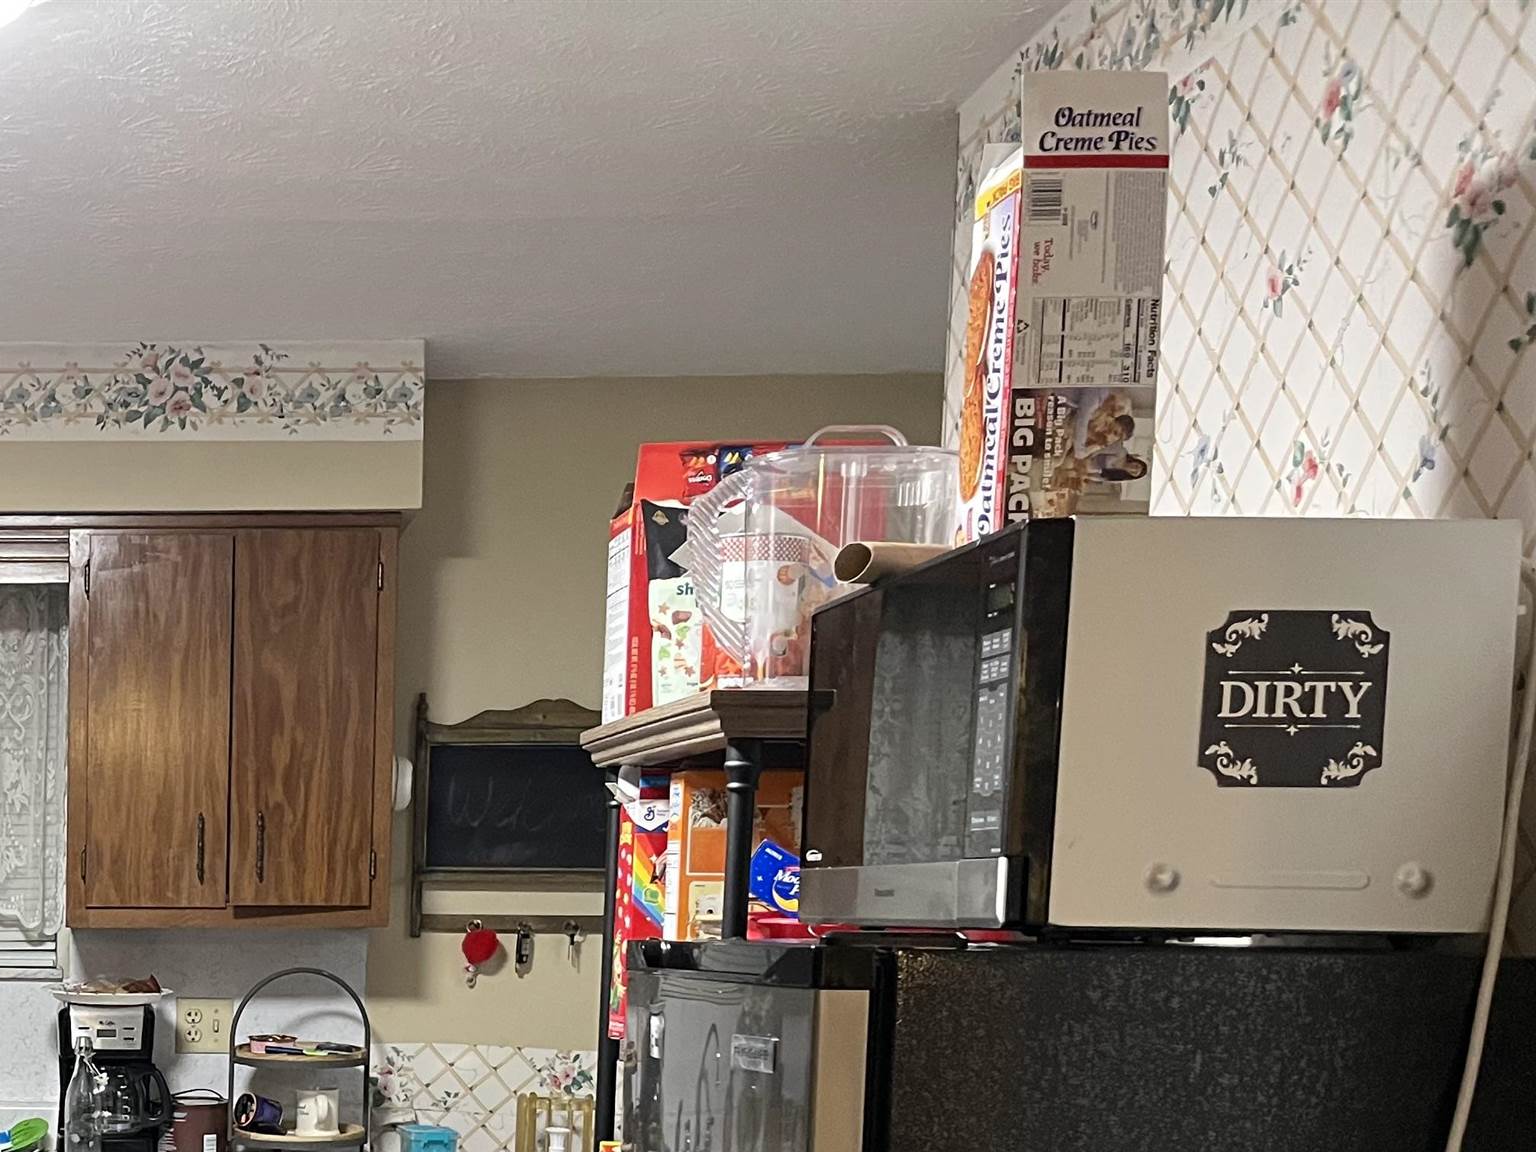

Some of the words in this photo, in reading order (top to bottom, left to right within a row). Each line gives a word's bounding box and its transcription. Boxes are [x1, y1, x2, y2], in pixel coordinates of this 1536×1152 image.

[1054, 106, 1143, 127] Oatmeal
[1039, 131, 1105, 152] Creme
[1108, 130, 1158, 152] Pies
[993, 213, 1012, 297] Pies
[1148, 299, 1160, 346] Nutrition
[984, 298, 1006, 405] Creme
[1146, 349, 1157, 378] Facts
[1012, 398, 1035, 447] BIG
[976, 405, 1000, 536] Oatmeal
[1217, 680, 1373, 719] DIRTY
